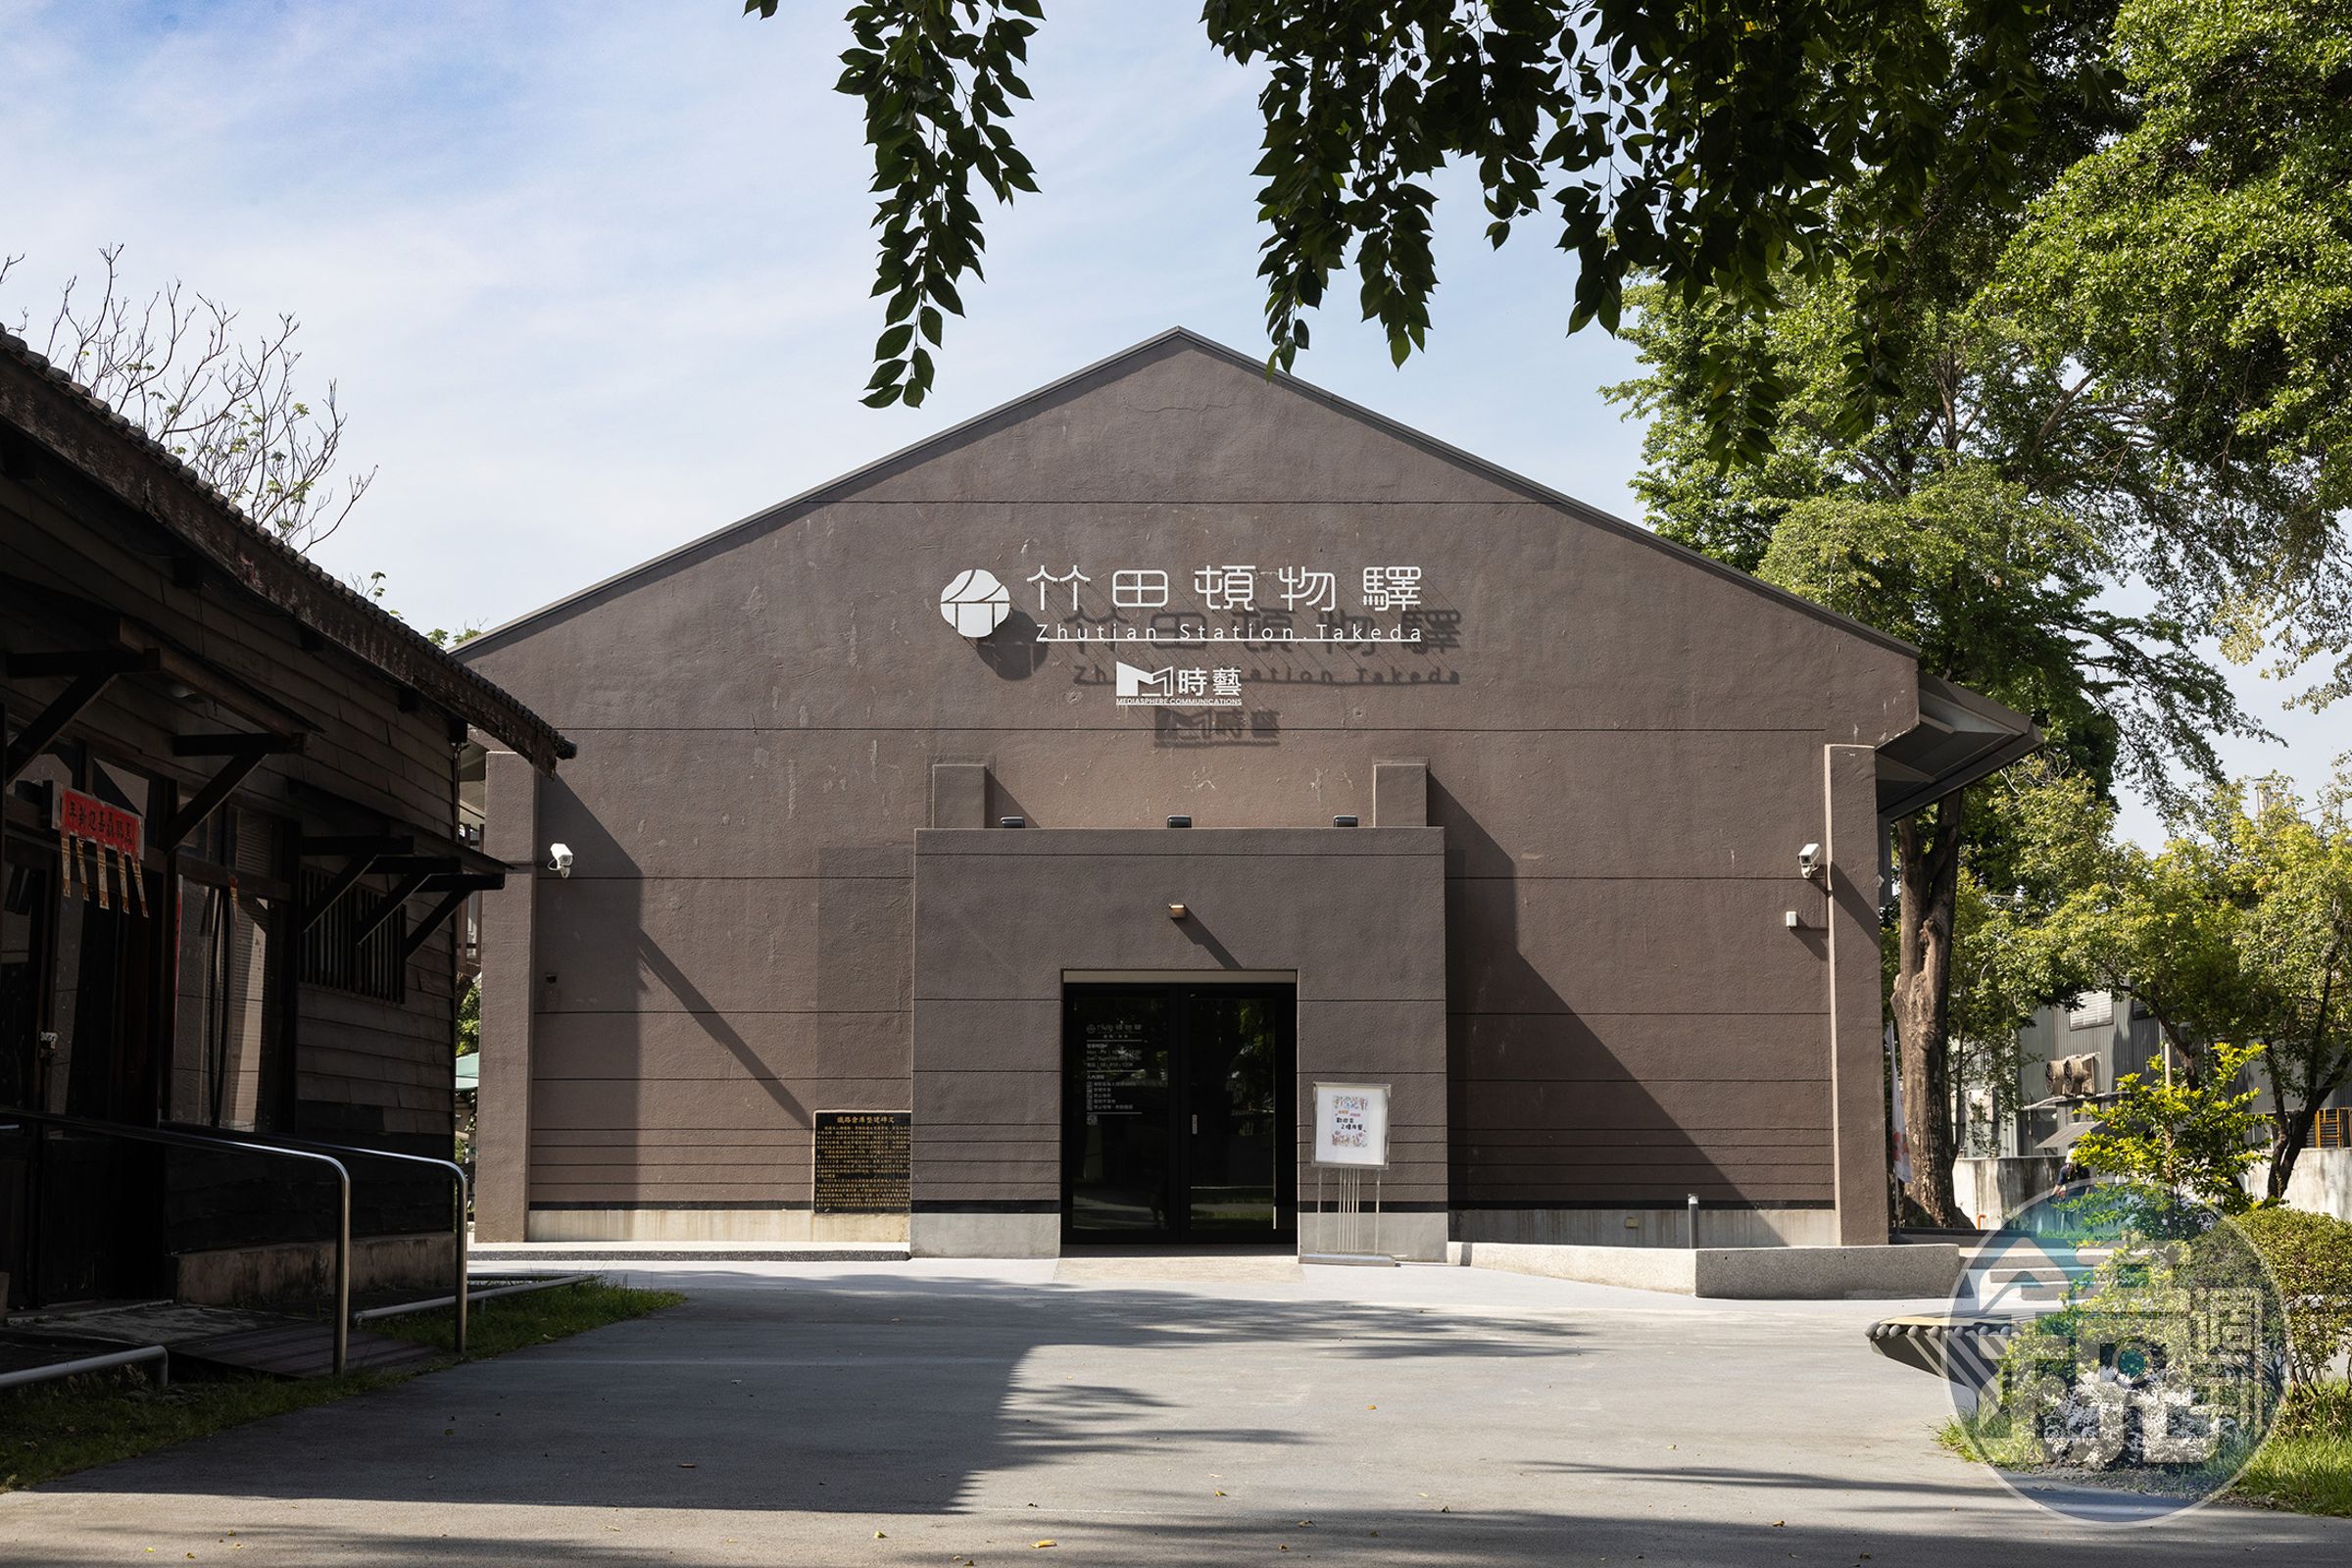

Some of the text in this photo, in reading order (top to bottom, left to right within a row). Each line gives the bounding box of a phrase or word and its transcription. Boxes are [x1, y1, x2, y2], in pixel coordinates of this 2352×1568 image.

[1027, 564, 1421, 612] 竹田頓物驛
[1037, 624, 1156, 640] Zhutian
[1178, 667, 1242, 697] 時藝
